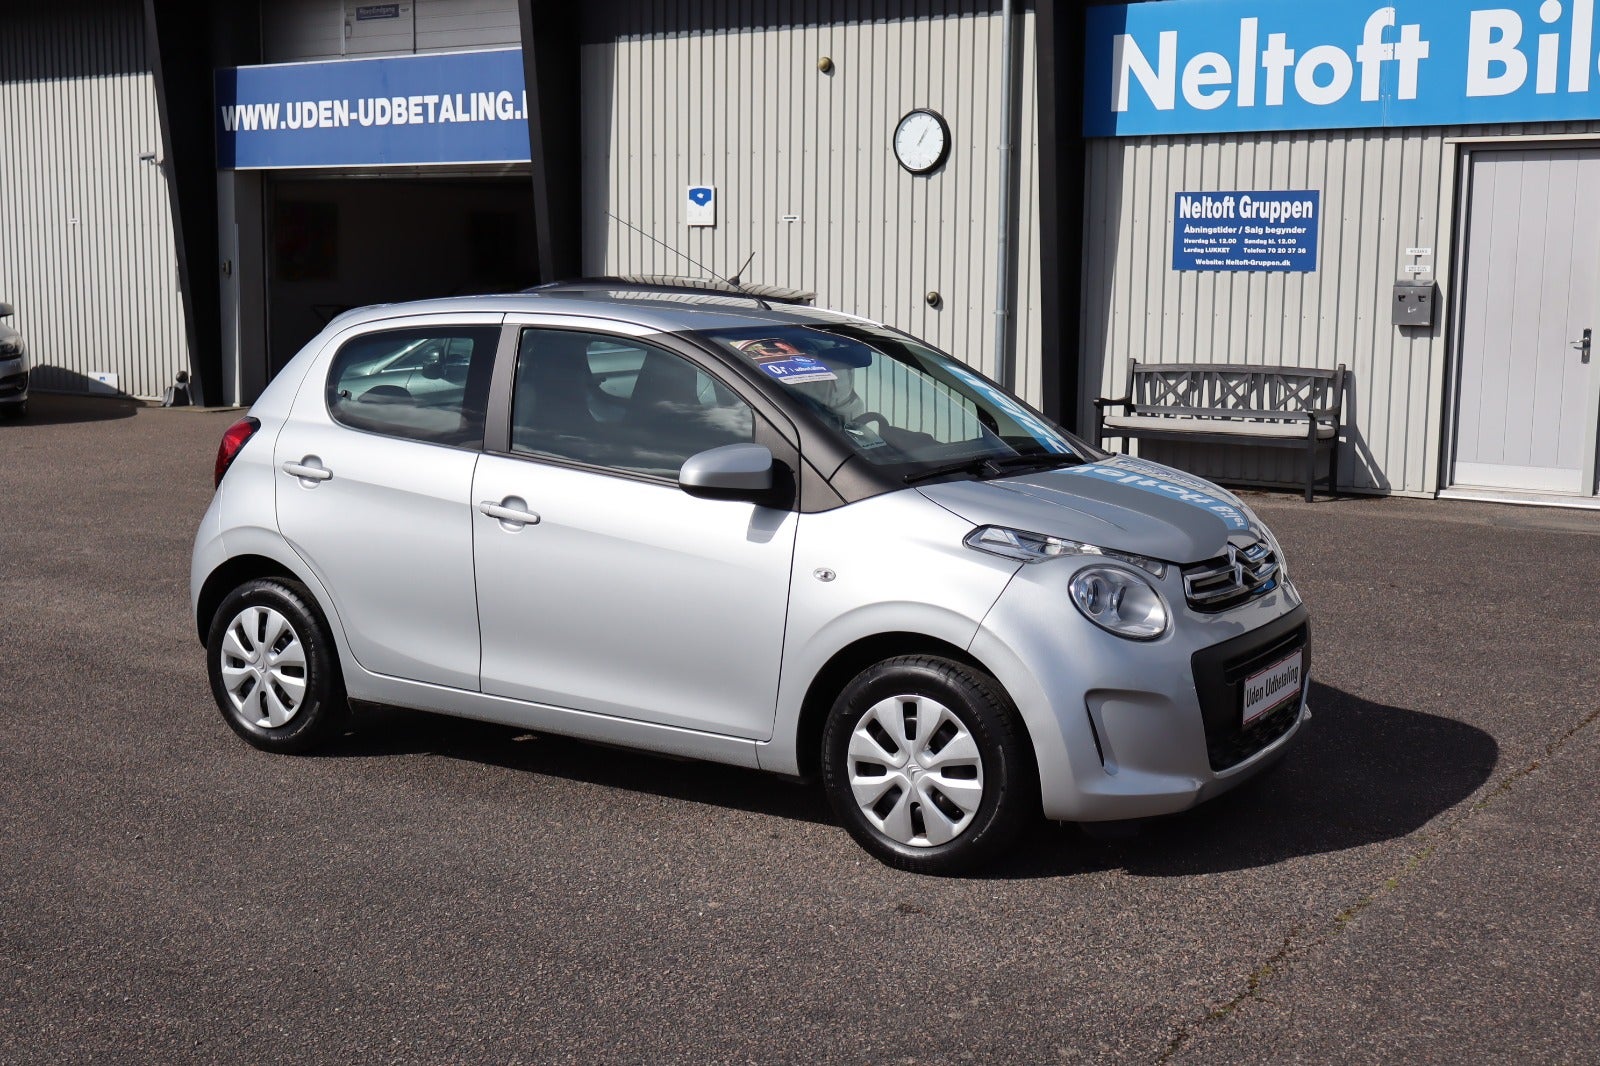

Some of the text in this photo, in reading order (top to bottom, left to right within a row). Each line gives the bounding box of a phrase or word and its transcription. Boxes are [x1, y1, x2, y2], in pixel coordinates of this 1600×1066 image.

[1111, 0, 1600, 113] Neltoft Bil
[1179, 195, 1313, 223] Neltoft Gruppen
[1184, 224, 1237, 234] Åbningstider
[1244, 226, 1264, 235] Salg
[1266, 226, 1306, 235] begynder
[1246, 666, 1298, 708] Uden Udbetaling
